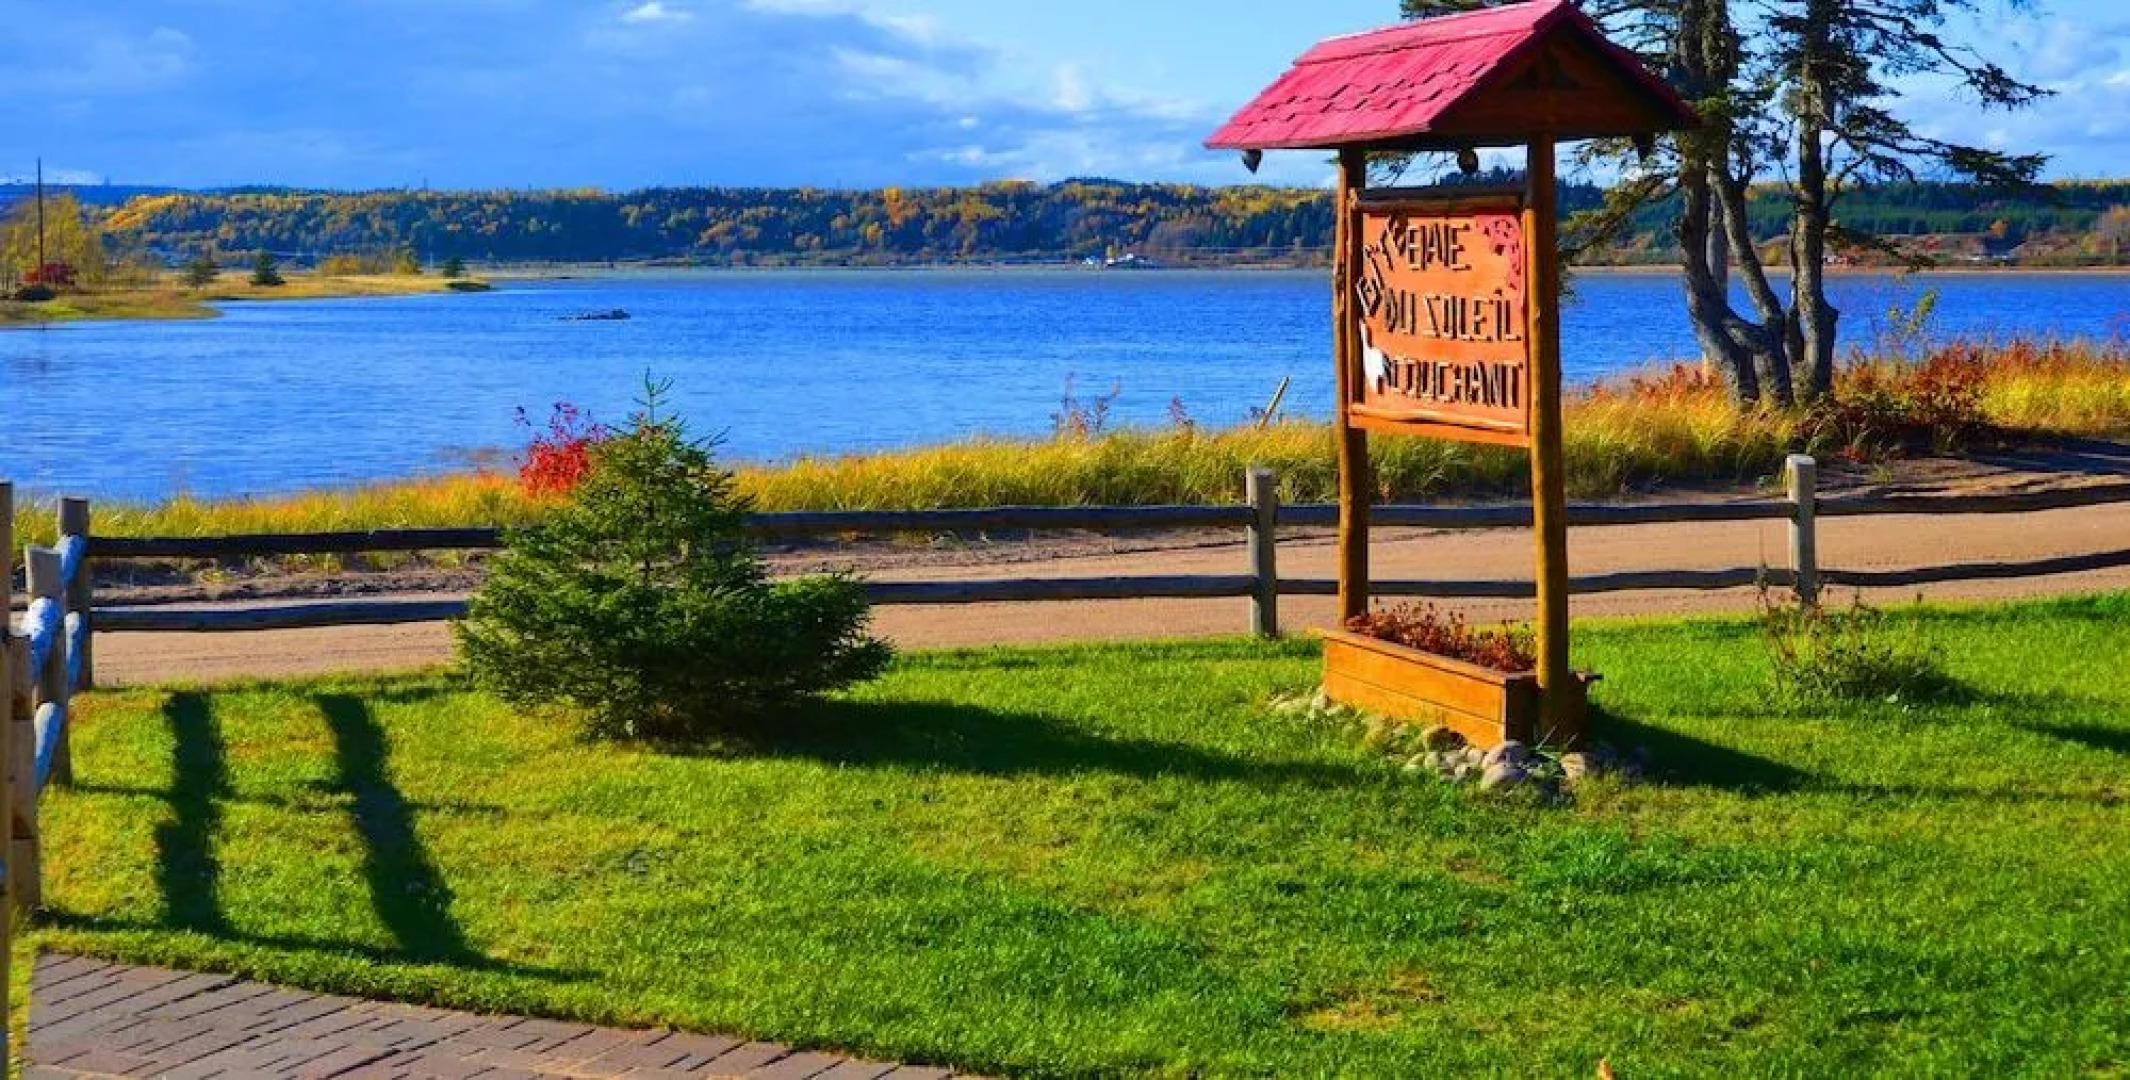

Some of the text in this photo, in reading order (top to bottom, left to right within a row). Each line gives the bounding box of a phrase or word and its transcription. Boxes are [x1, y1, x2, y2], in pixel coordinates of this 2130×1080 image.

[1407, 222, 1472, 271] BAIE
[1385, 289, 1415, 335] DU
[1391, 355, 1524, 409] COUCHANT
